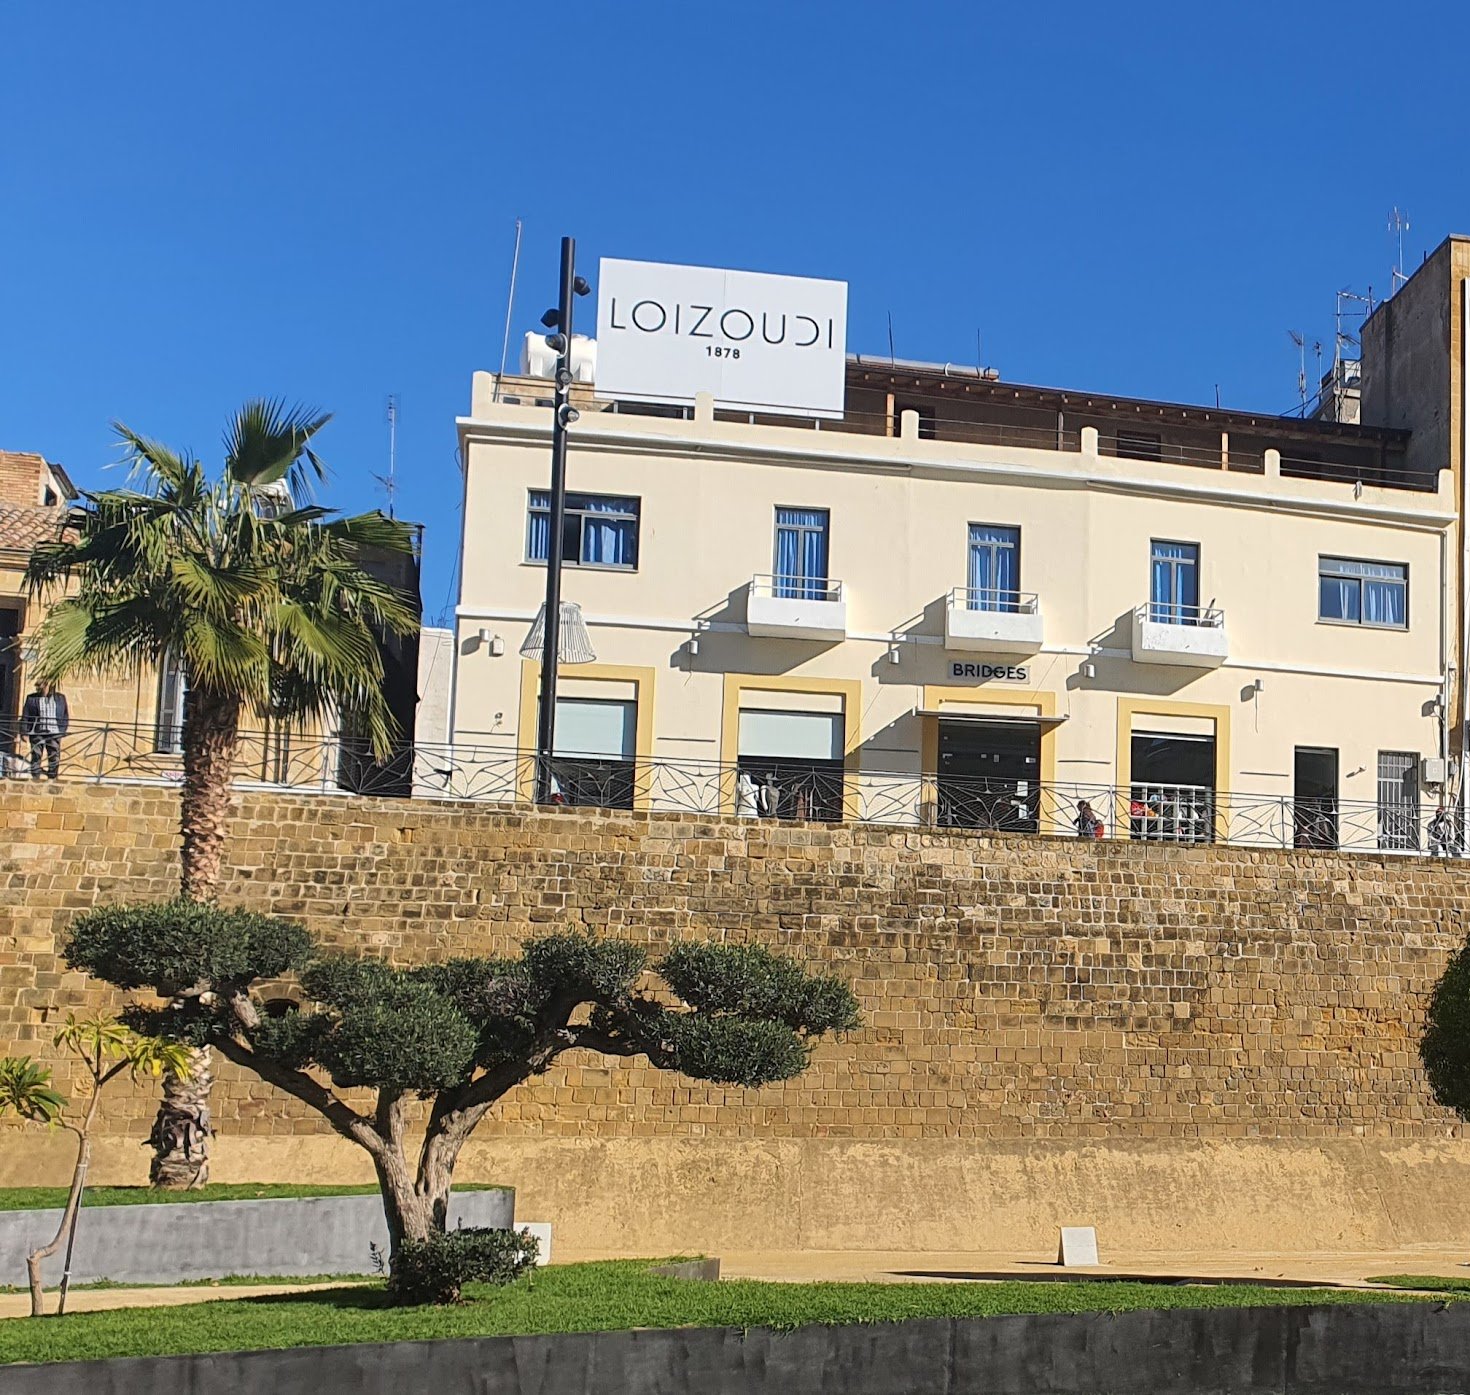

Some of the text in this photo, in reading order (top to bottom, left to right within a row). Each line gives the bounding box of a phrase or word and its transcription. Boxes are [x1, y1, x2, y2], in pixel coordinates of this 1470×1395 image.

[610, 297, 833, 349] LOIZOUDI
[705, 346, 741, 359] 1878
[953, 663, 1027, 680] BRIDGES
